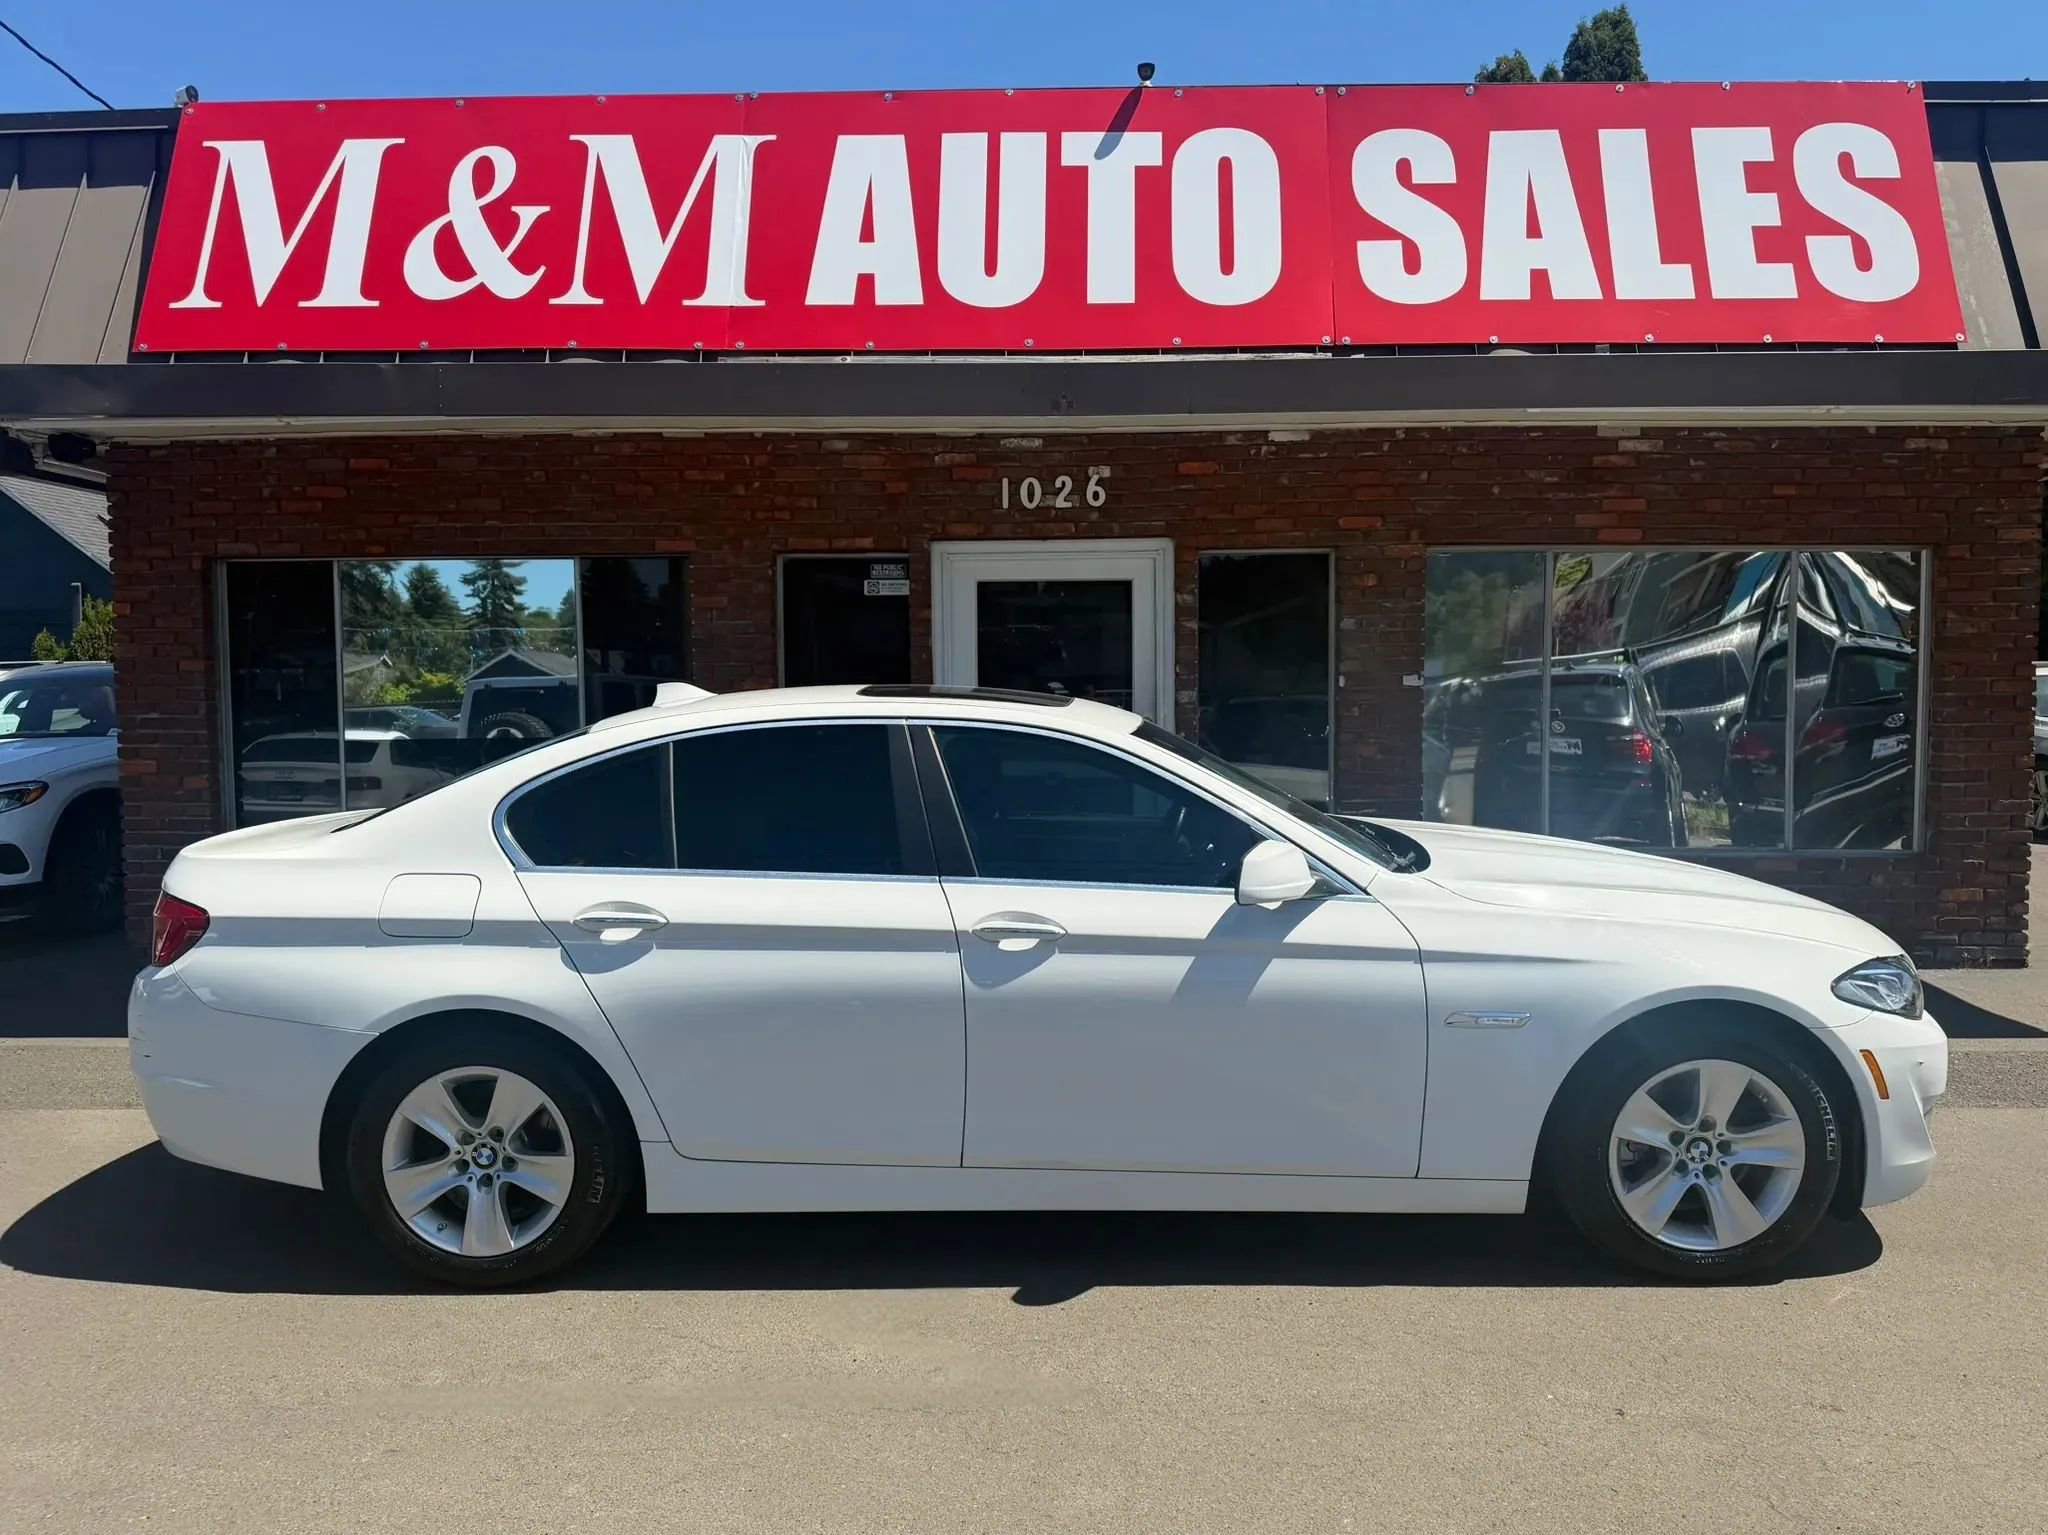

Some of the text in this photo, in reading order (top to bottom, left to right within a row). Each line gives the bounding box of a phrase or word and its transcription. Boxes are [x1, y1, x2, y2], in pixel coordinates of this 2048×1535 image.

[168, 122, 1921, 309] M&M AUTO SALES
[1002, 474, 1107, 509] 1026
